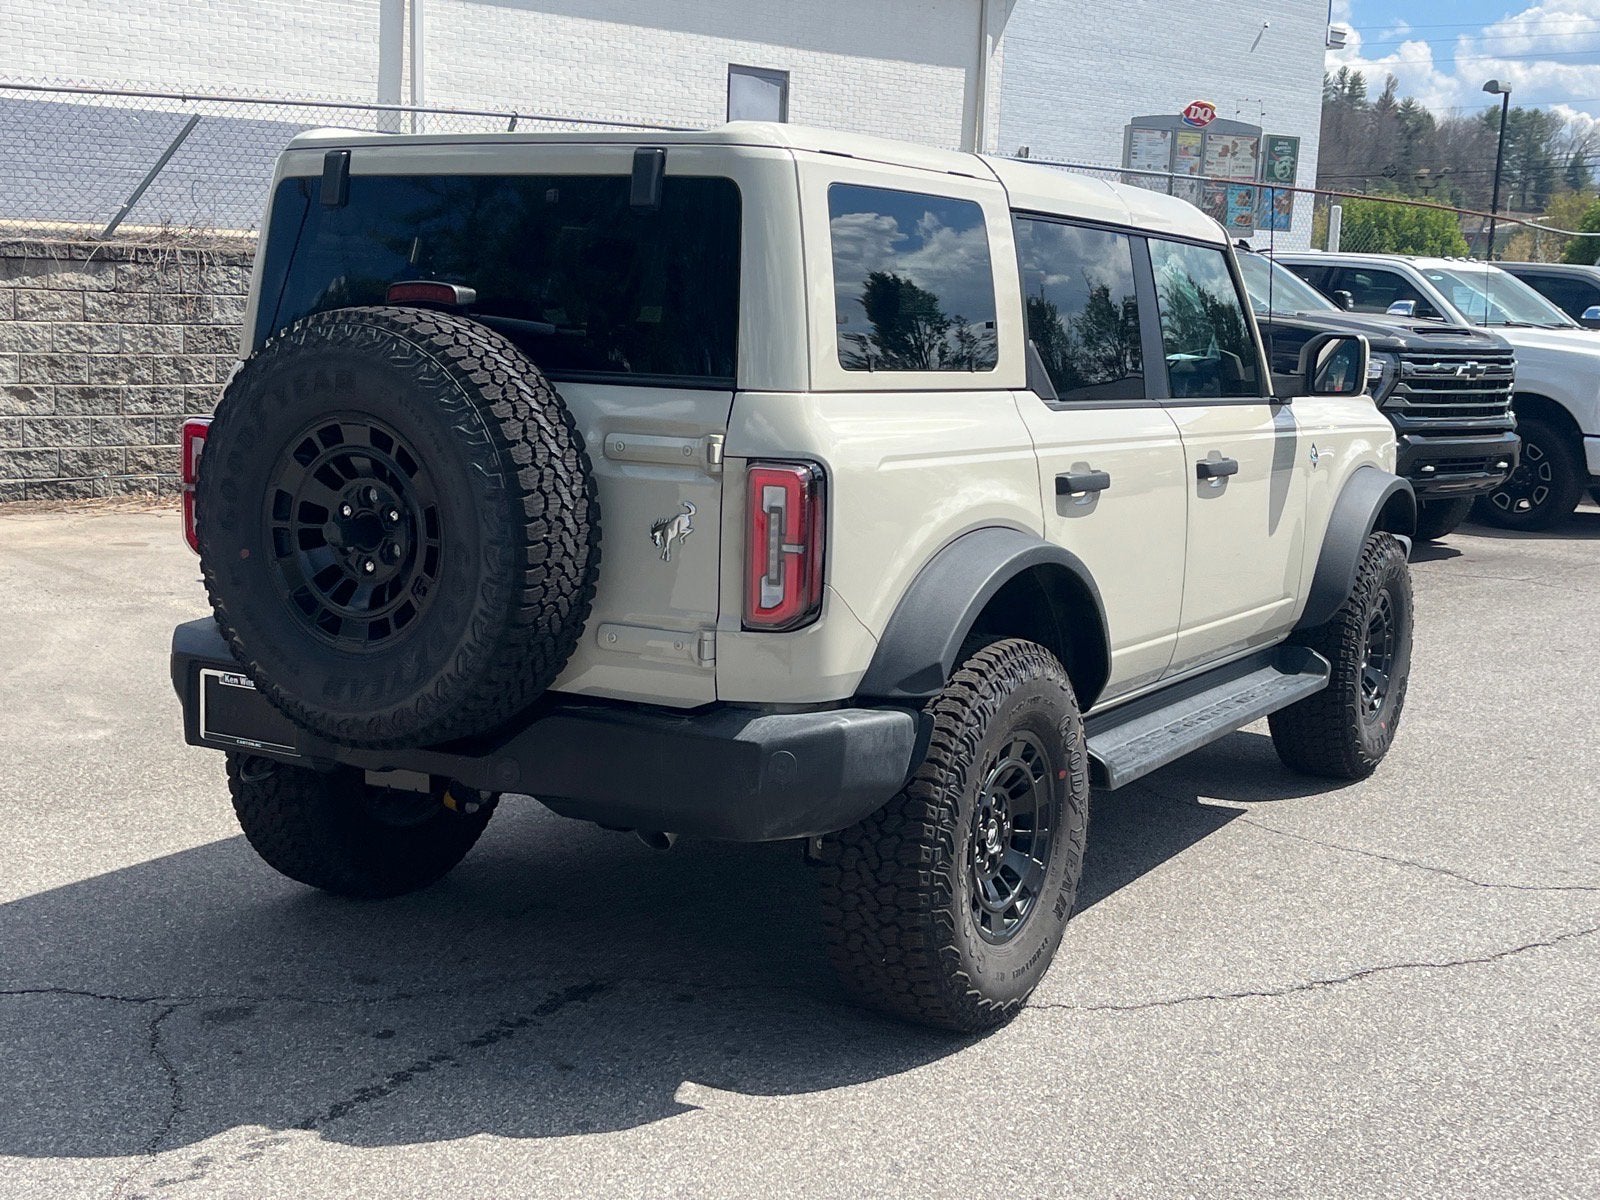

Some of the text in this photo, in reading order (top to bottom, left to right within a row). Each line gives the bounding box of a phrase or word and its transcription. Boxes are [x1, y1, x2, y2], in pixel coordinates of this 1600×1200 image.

[1188, 105, 1212, 122] DQ
[224, 674, 239, 685] Ken
[1053, 713, 1088, 923] GOODYEAR
